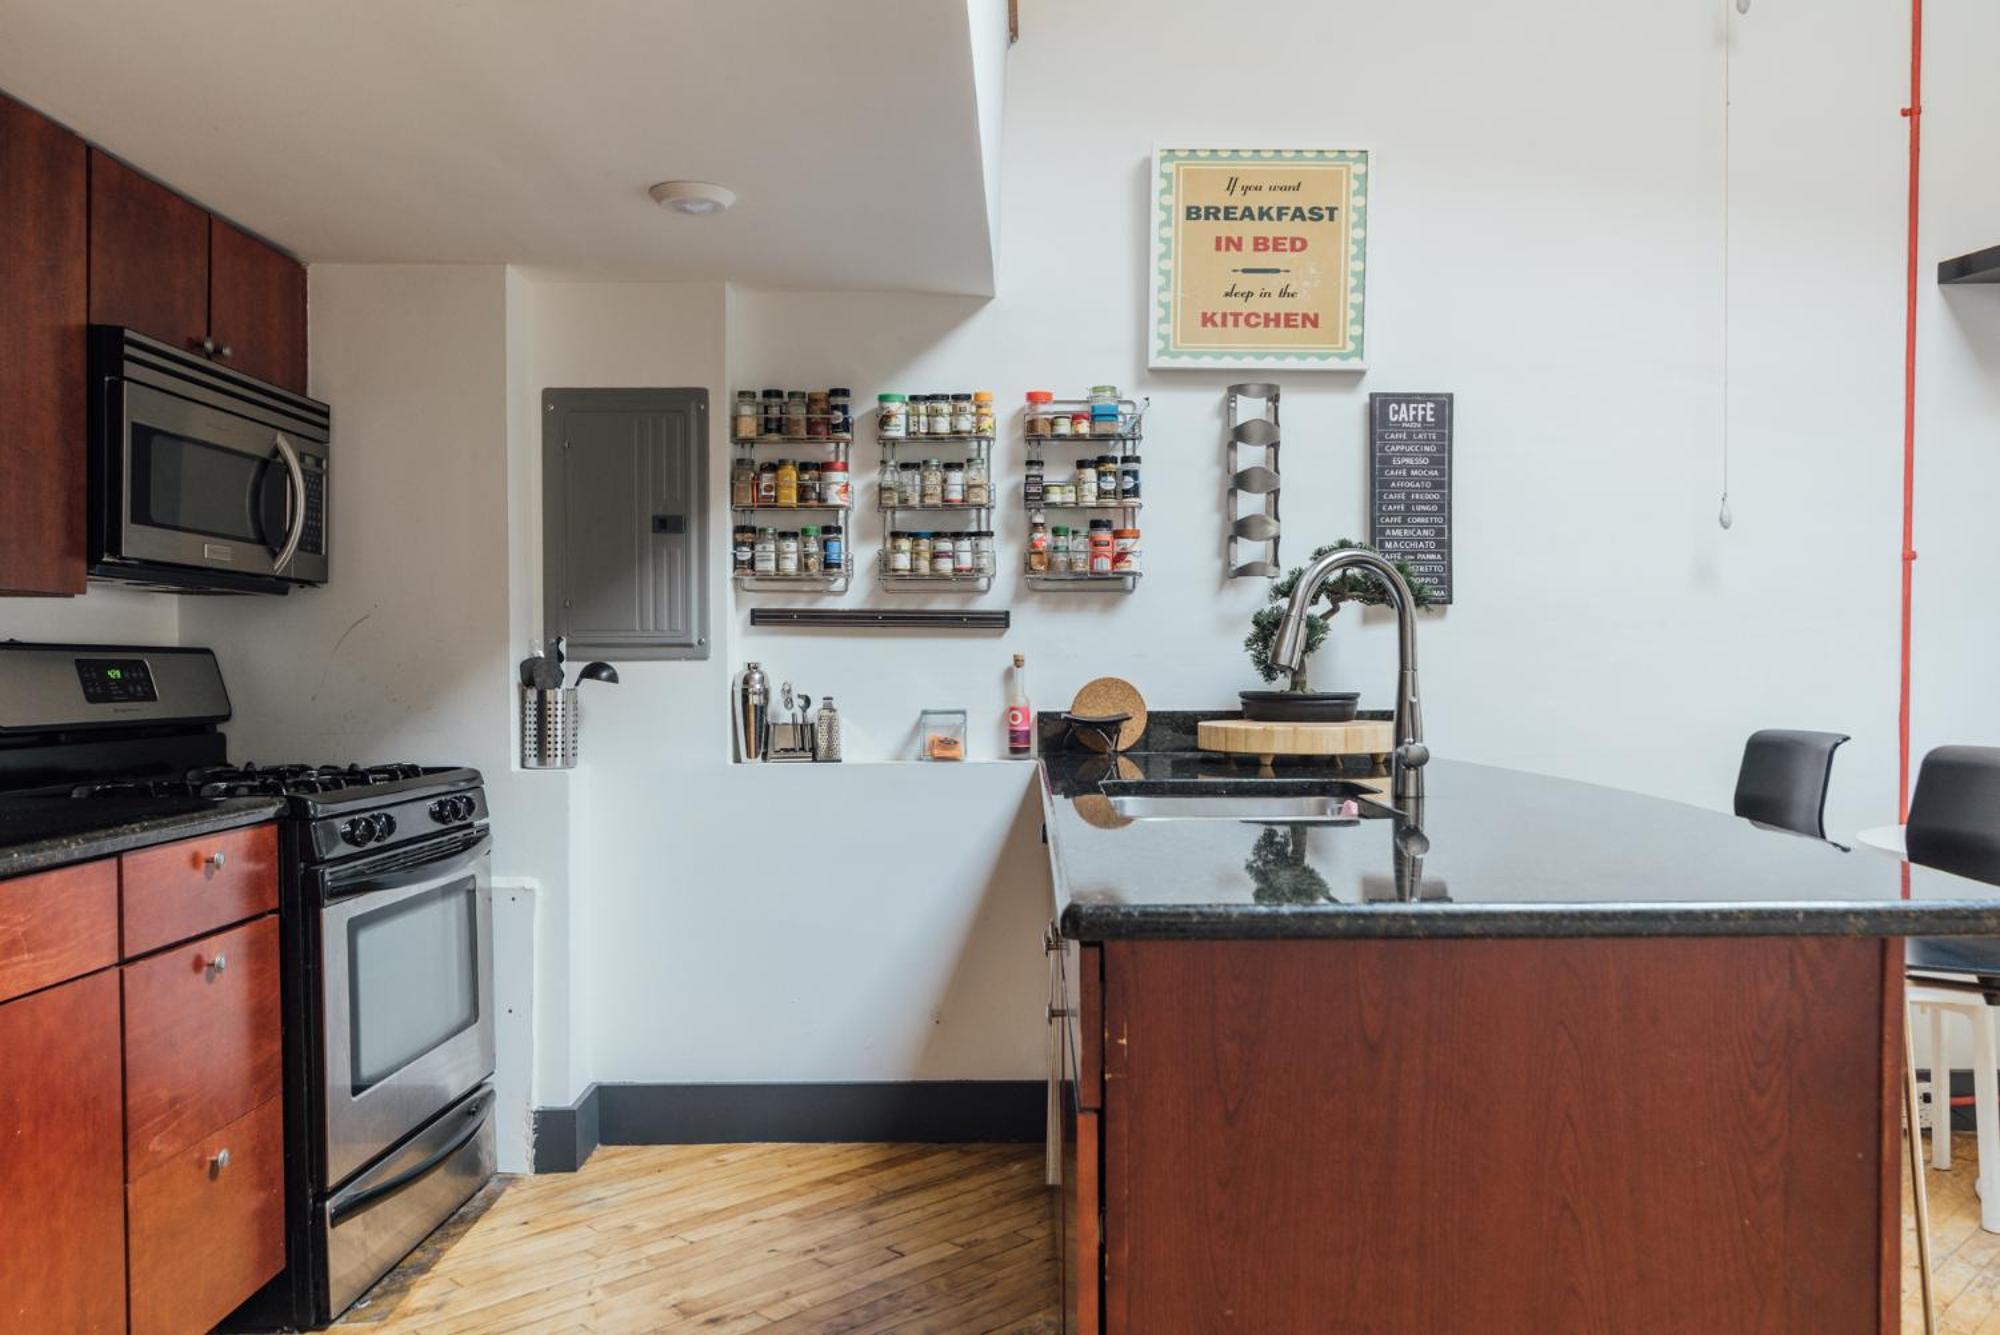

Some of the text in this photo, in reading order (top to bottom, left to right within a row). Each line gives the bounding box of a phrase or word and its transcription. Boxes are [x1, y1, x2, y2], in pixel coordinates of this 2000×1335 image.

[1225, 176, 1302, 196] If you want
[1185, 205, 1339, 222] BREAKFAST
[1214, 235, 1309, 253] IN BED
[1223, 283, 1299, 303] sleep in the
[1200, 311, 1320, 329] KITCHEN
[1412, 432, 1437, 440] LATTE
[1384, 444, 1437, 452] CAPPUCCINO
[1392, 456, 1430, 465] ESPRESSO
[1390, 480, 1432, 488] AFFOGATO
[1407, 516, 1444, 524] CORRETTO
[1384, 528, 1436, 537] AMERICANO
[1384, 541, 1436, 549] MACCHIATO
